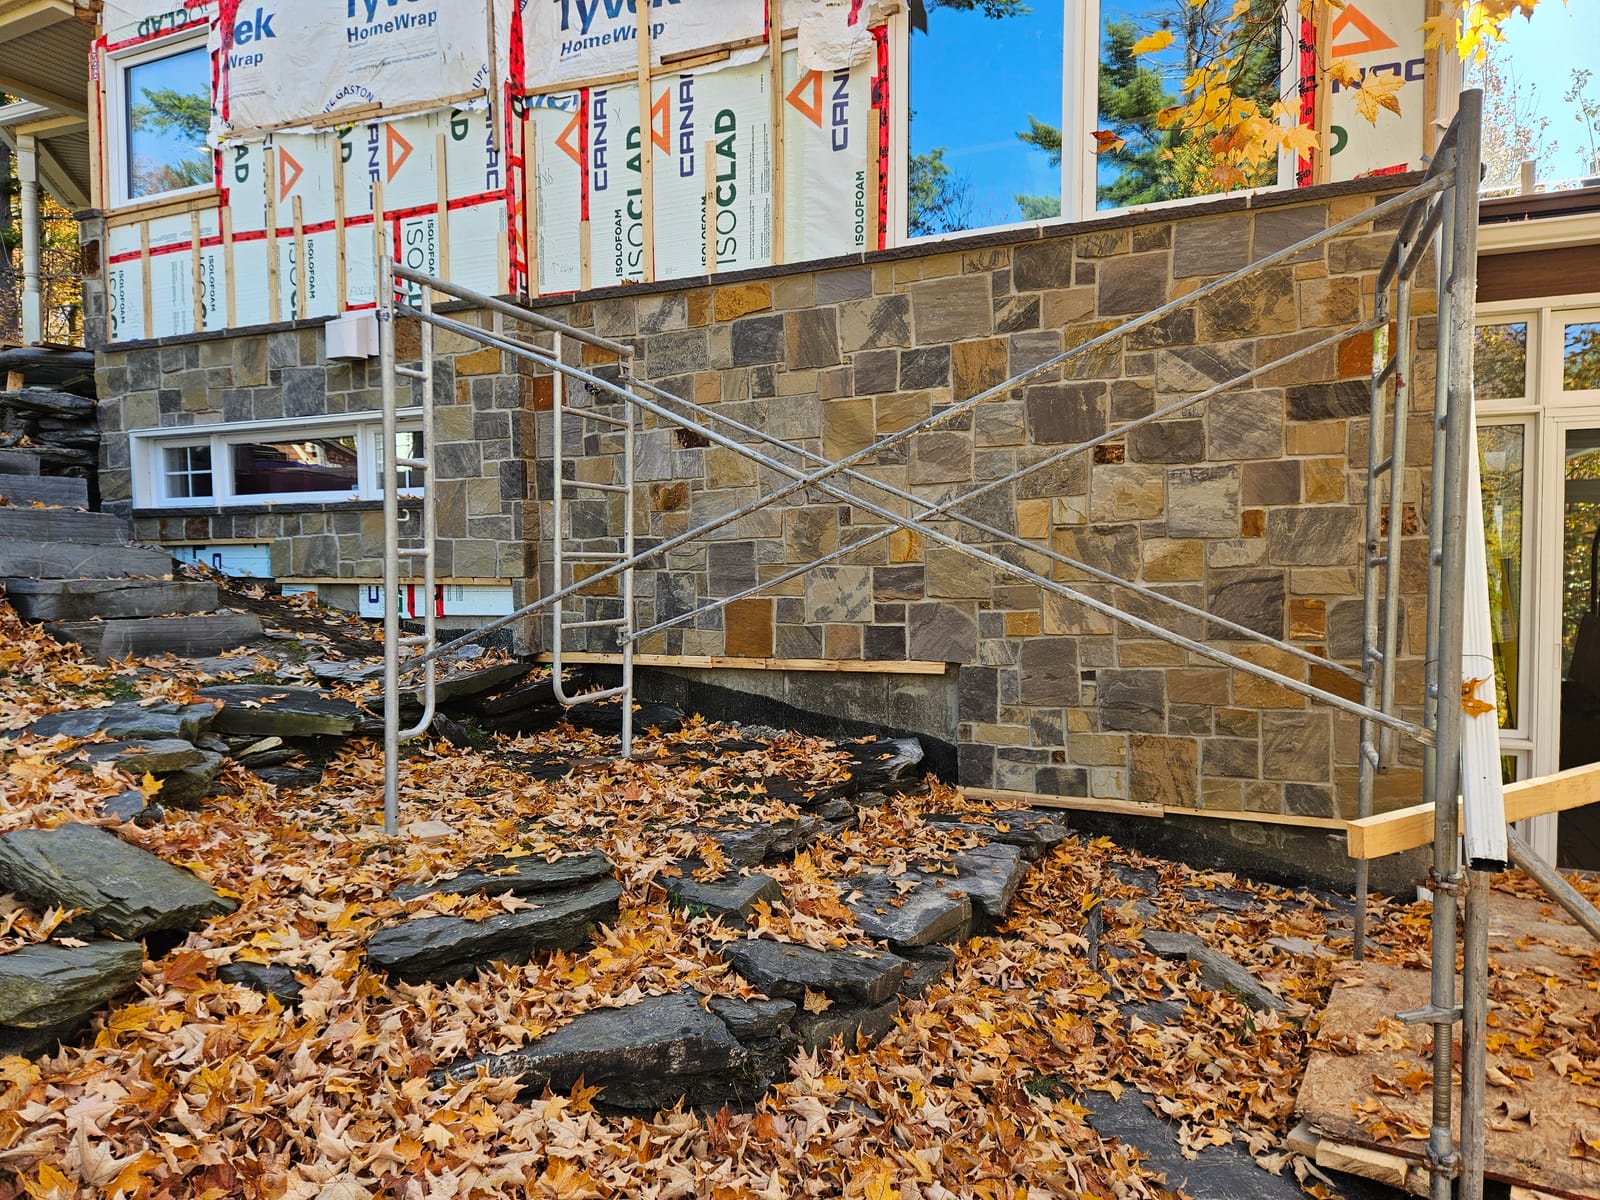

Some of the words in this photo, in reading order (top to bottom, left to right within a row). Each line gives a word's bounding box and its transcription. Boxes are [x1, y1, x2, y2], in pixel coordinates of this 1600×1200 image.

[346, 10, 438, 43] HomeWrap
[560, 22, 666, 56] HomeWrp
[335, 85, 375, 103] GASTON
[680, 74, 694, 178] CANA
[832, 67, 849, 152] CAN
[594, 90, 608, 191] CANA
[714, 108, 737, 265] ISOCLAD
[855, 170, 865, 246] ISOLOFOAM
[307, 239, 316, 299] ISOLOFOAM
[614, 209, 623, 277] ISOLOFOAM
[208, 255, 216, 312] ISOLOFOAM
